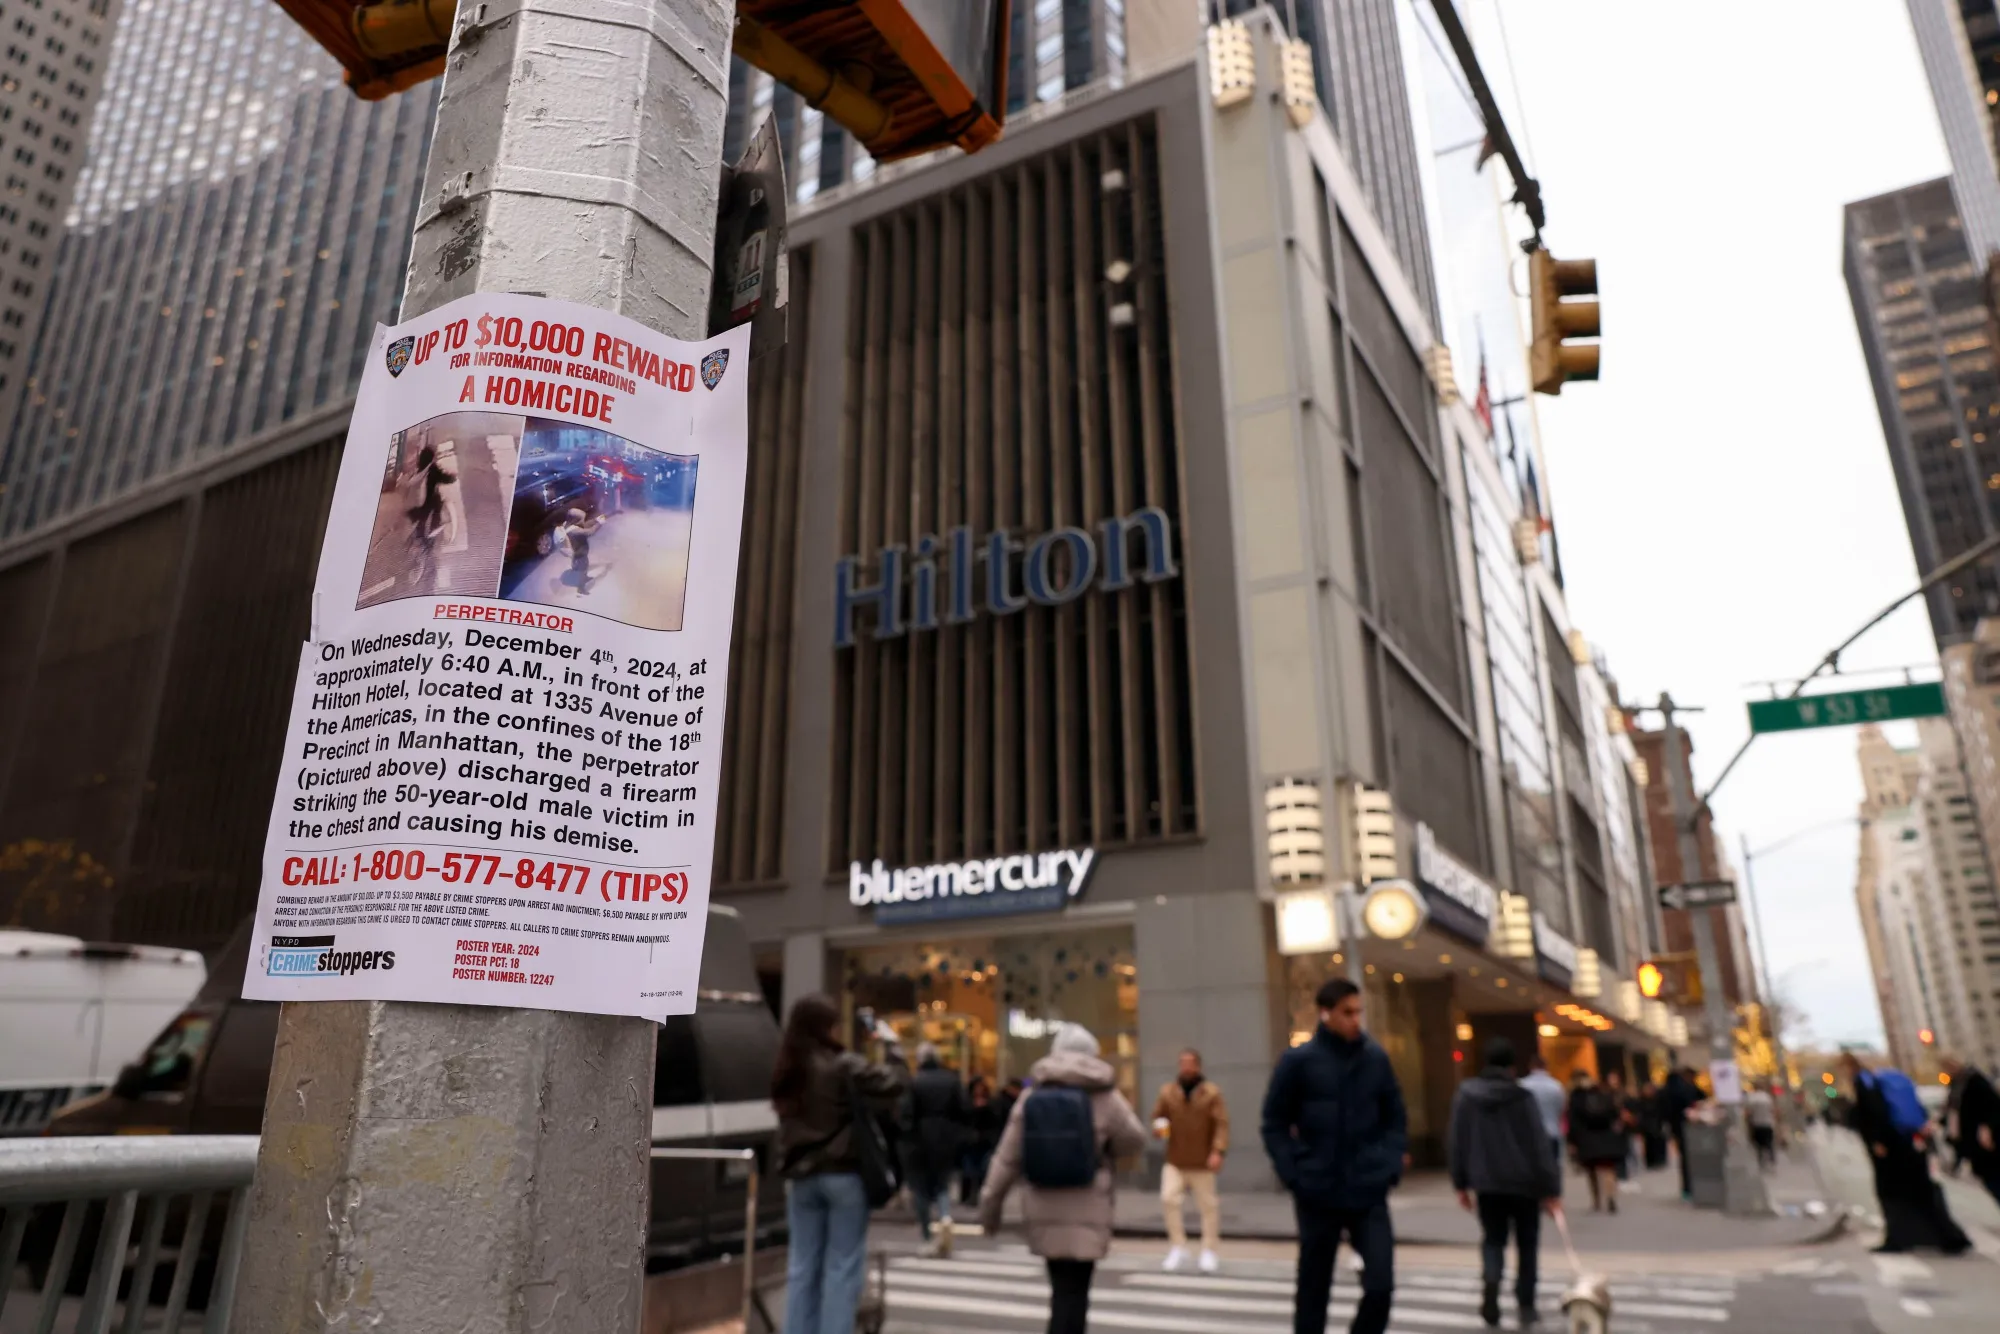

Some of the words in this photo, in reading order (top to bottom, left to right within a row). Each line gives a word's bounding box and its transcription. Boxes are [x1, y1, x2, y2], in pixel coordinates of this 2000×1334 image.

[415, 330, 440, 366] UP
[443, 318, 469, 353] TO
[474, 312, 585, 357] $10,000
[592, 332, 696, 393] REWARD
[450, 352, 470, 370] FOR
[474, 352, 562, 375] INFORMATION
[566, 362, 636, 395] REGARDING
[459, 375, 475, 403] A
[484, 375, 615, 424] HOMICIDE
[833, 506, 1179, 648] Hilton
[434, 604, 573, 632] PERPETRATOR
[321, 644, 345, 661] On
[351, 628, 453, 656] Wednesday,
[465, 629, 582, 660] December
[627, 658, 681, 681] 2024,
[689, 659, 707, 676] at
[315, 653, 433, 690] approximately
[441, 653, 490, 673] 6:40
[497, 658, 554, 685] A.M.,
[564, 667, 583, 687] in
[591, 673, 640, 700] front
[648, 686, 670, 702] of
[676, 684, 705, 701] the
[312, 691, 361, 710] Hilton
[366, 680, 409, 703] Hotel,
[417, 679, 503, 701] located
[510, 687, 533, 705] at
[543, 689, 593, 715] 1335
[599, 701, 678, 727] Avenue
[684, 706, 704, 725] of
[307, 718, 338, 735] the
[341, 708, 417, 733] Americas,
[425, 704, 445, 722] in
[453, 706, 490, 726] the
[497, 713, 595, 741] confines
[601, 730, 622, 747] of
[628, 733, 662, 752] the
[302, 737, 370, 760] Precinct
[375, 734, 390, 752] in
[397, 730, 524, 759] Manhattan,
[537, 741, 573, 763] the
[582, 752, 700, 777] perpetrator
[297, 761, 372, 790] (pictured
[377, 757, 446, 780] above)
[458, 759, 591, 793] discharged
[600, 782, 612, 798] a
[622, 782, 697, 803] firearm
[293, 792, 357, 813] striking
[363, 786, 387, 806] the
[394, 783, 528, 811] 50-year-old
[538, 798, 593, 820] male
[602, 807, 668, 828] victim
[677, 809, 695, 827] in
[289, 820, 322, 838] the
[326, 815, 364, 838] chest
[367, 811, 401, 832] and
[407, 814, 502, 841] causing
[510, 818, 546, 840] his
[553, 824, 639, 854] demise.
[282, 855, 346, 887] CALL:
[352, 849, 591, 895] 1-800-577-8477
[600, 869, 690, 905] (TIPS)
[850, 847, 1095, 906] bluemercury
[275, 907, 298, 916] ARREST
[364, 903, 396, 912] RESPONSIBLE
[397, 903, 410, 912] FOR
[411, 903, 422, 912] THE
[423, 904, 444, 913] ABOVE
[445, 905, 466, 915] LISTED
[468, 907, 490, 917] CRIME.
[277, 895, 307, 904] COMBINED
[376, 891, 383, 899] UP
[384, 891, 391, 899] TO
[393, 891, 413, 900] $3,500
[415, 891, 441, 901] PAYABLE
[443, 894, 452, 902] BY
[453, 894, 473, 904] CRIME
[475, 895, 507, 906] STOPPERS
[508, 898, 525, 908] UPON
[527, 900, 551, 910] ARREST
[551, 902, 564, 911] AND
[602, 909, 623, 919] $6,500
[625, 911, 650, 920] PAYABLE
[651, 911, 658, 920] BY
[659, 912, 673, 920] NYPD
[673, 911, 687, 919] UPON
[273, 918, 297, 927] ANYONE
[367, 914, 382, 924] CRIME
[383, 914, 390, 923] IS
[390, 915, 410, 924] URGED
[412, 915, 420, 924] TO
[421, 916, 450, 926] CONTACT
[452, 917, 472, 927] CRIME
[473, 919, 508, 930] STOPPERS.
[510, 922, 521, 931] ALL
[523, 923, 550, 935] CALLERS
[551, 926, 559, 935] TO
[560, 927, 580, 937] CRIME
[581, 929, 610, 941] STOPPERS
[611, 933, 635, 943] REMAIN
[274, 938, 300, 946] NYPD
[456, 939, 489, 952] POSTER
[492, 942, 515, 954] YEAR:
[517, 944, 540, 957] 2024
[452, 967, 485, 981] POSTER
[487, 970, 527, 984] NUMBER:
[529, 973, 555, 986] 12247
[454, 953, 487, 967] POSTER
[489, 956, 508, 968] PCT:
[510, 957, 520, 969] 18
